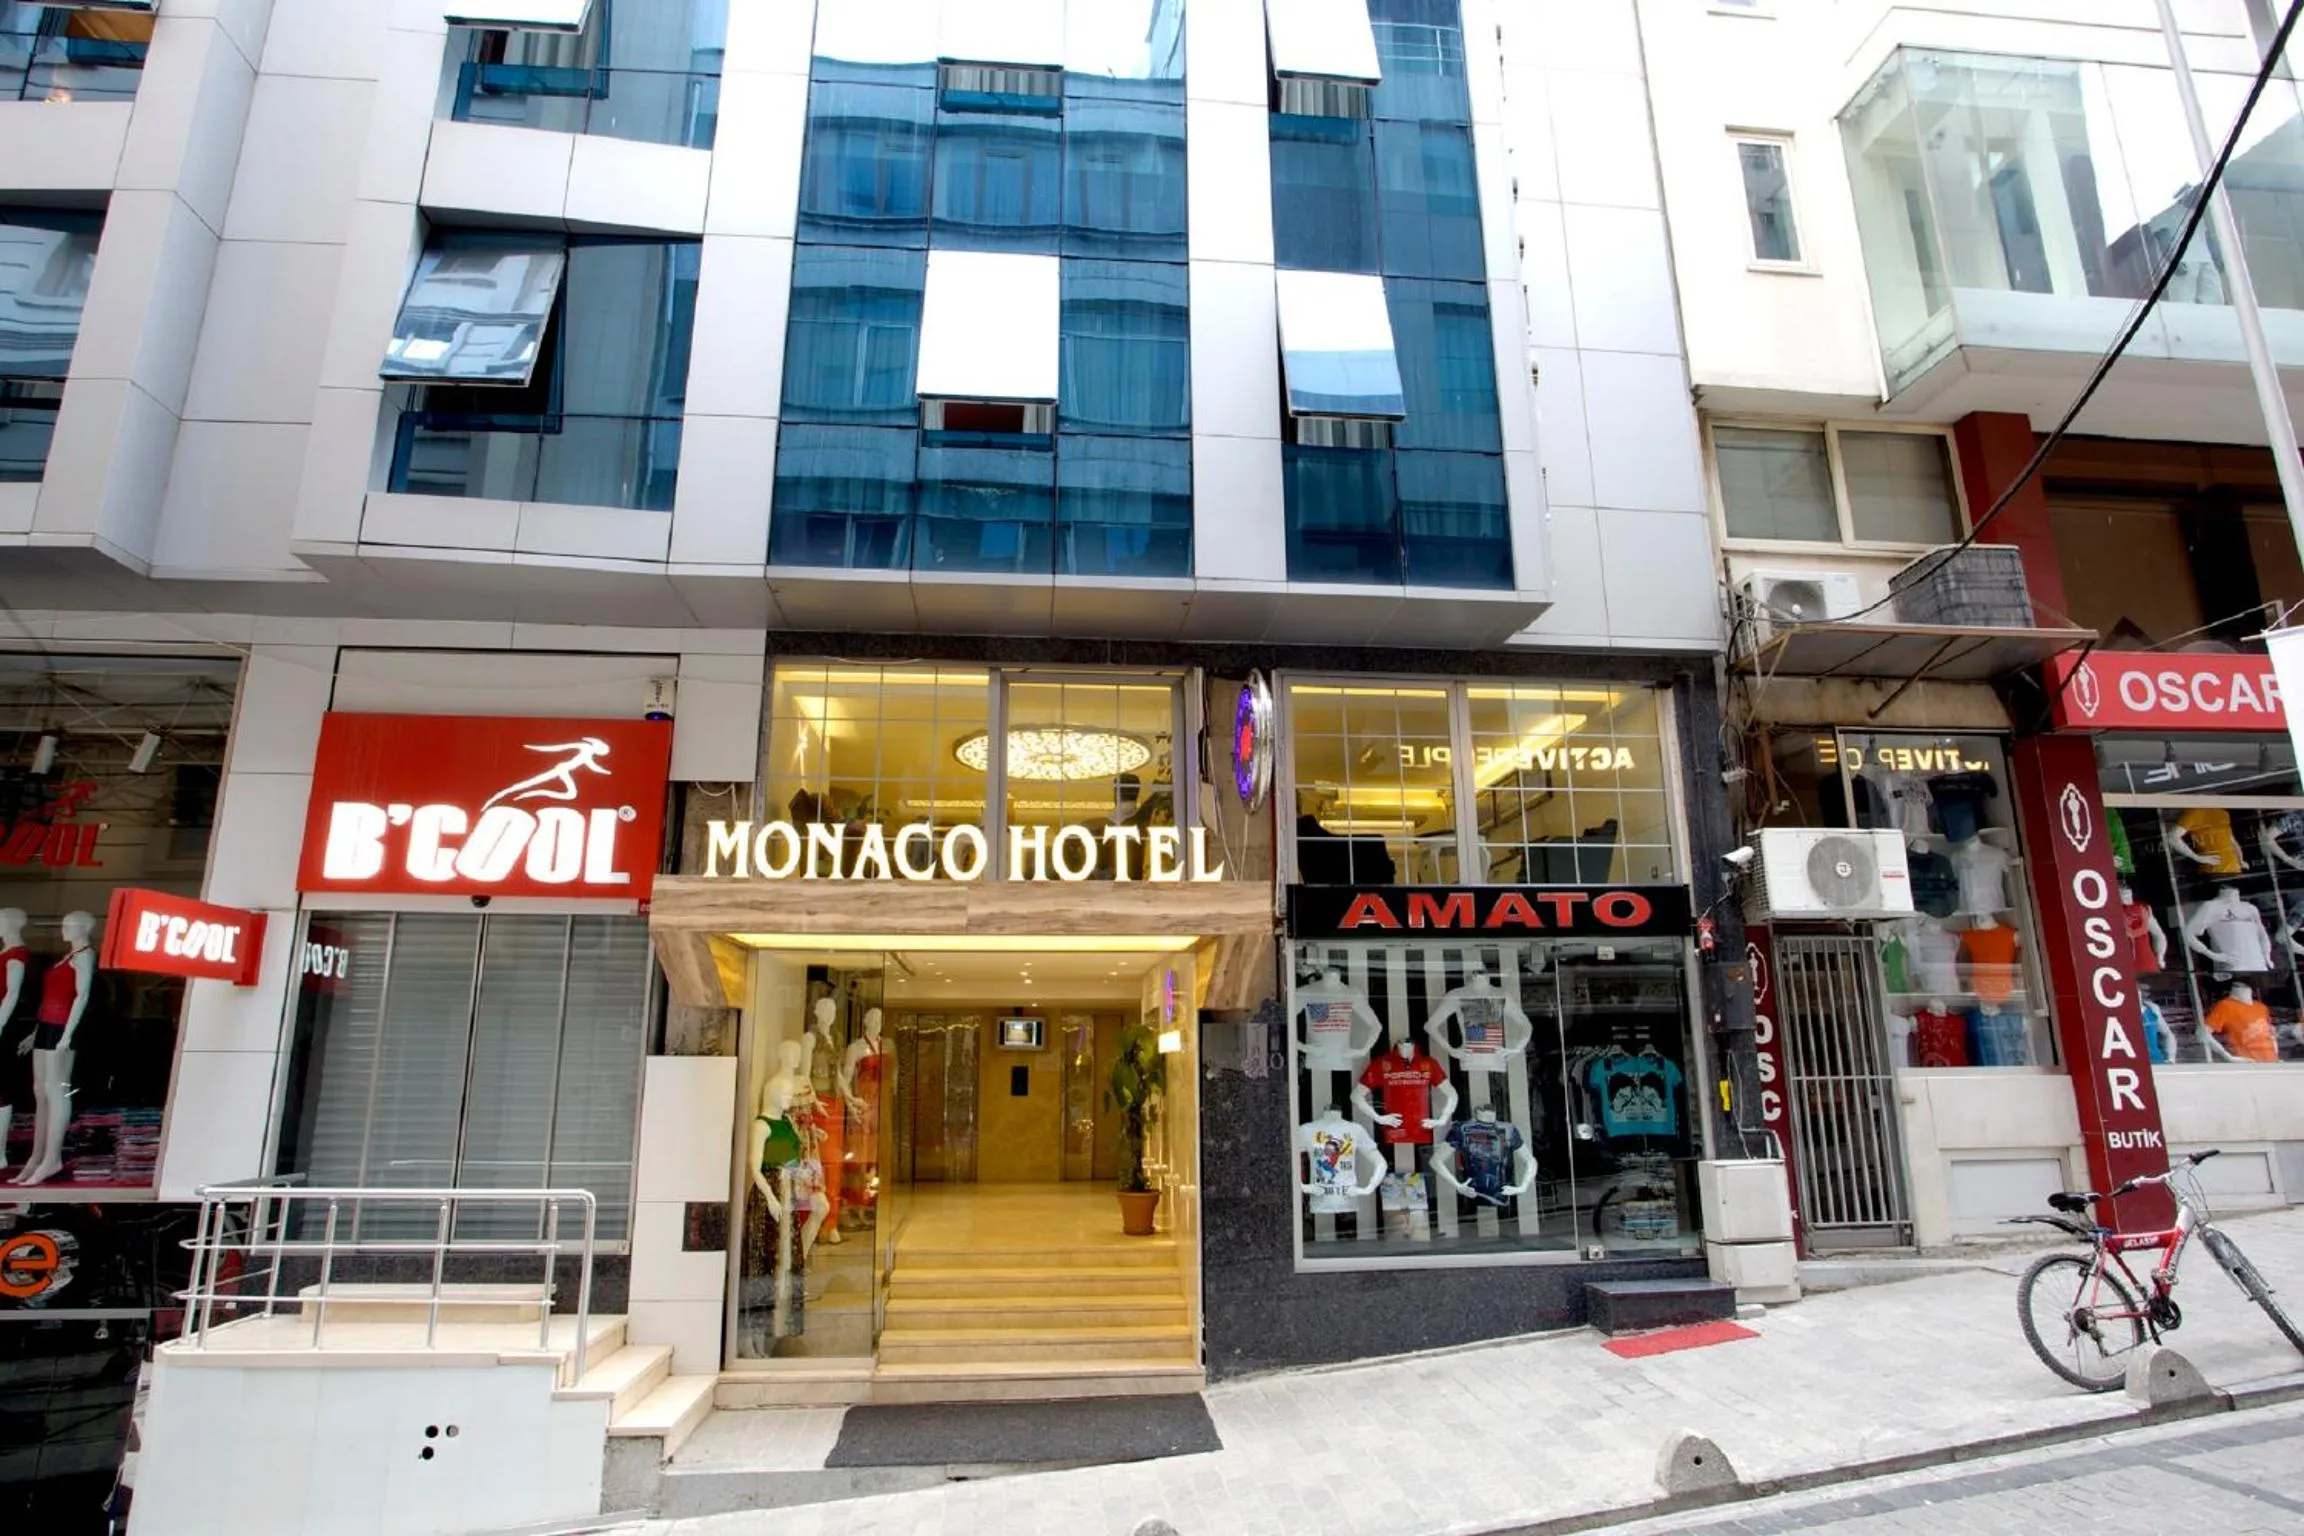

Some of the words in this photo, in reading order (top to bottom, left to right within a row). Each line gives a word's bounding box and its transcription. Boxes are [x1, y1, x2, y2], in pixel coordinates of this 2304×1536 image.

[705, 819, 988, 882] MONACO
[1008, 824, 1225, 883] HOTEL
[1337, 891, 1653, 928] AMATO
[135, 910, 240, 964] B'COOL
[2072, 868, 2145, 1111] OSCAR
[2107, 1128, 2163, 1149] BUTİK
